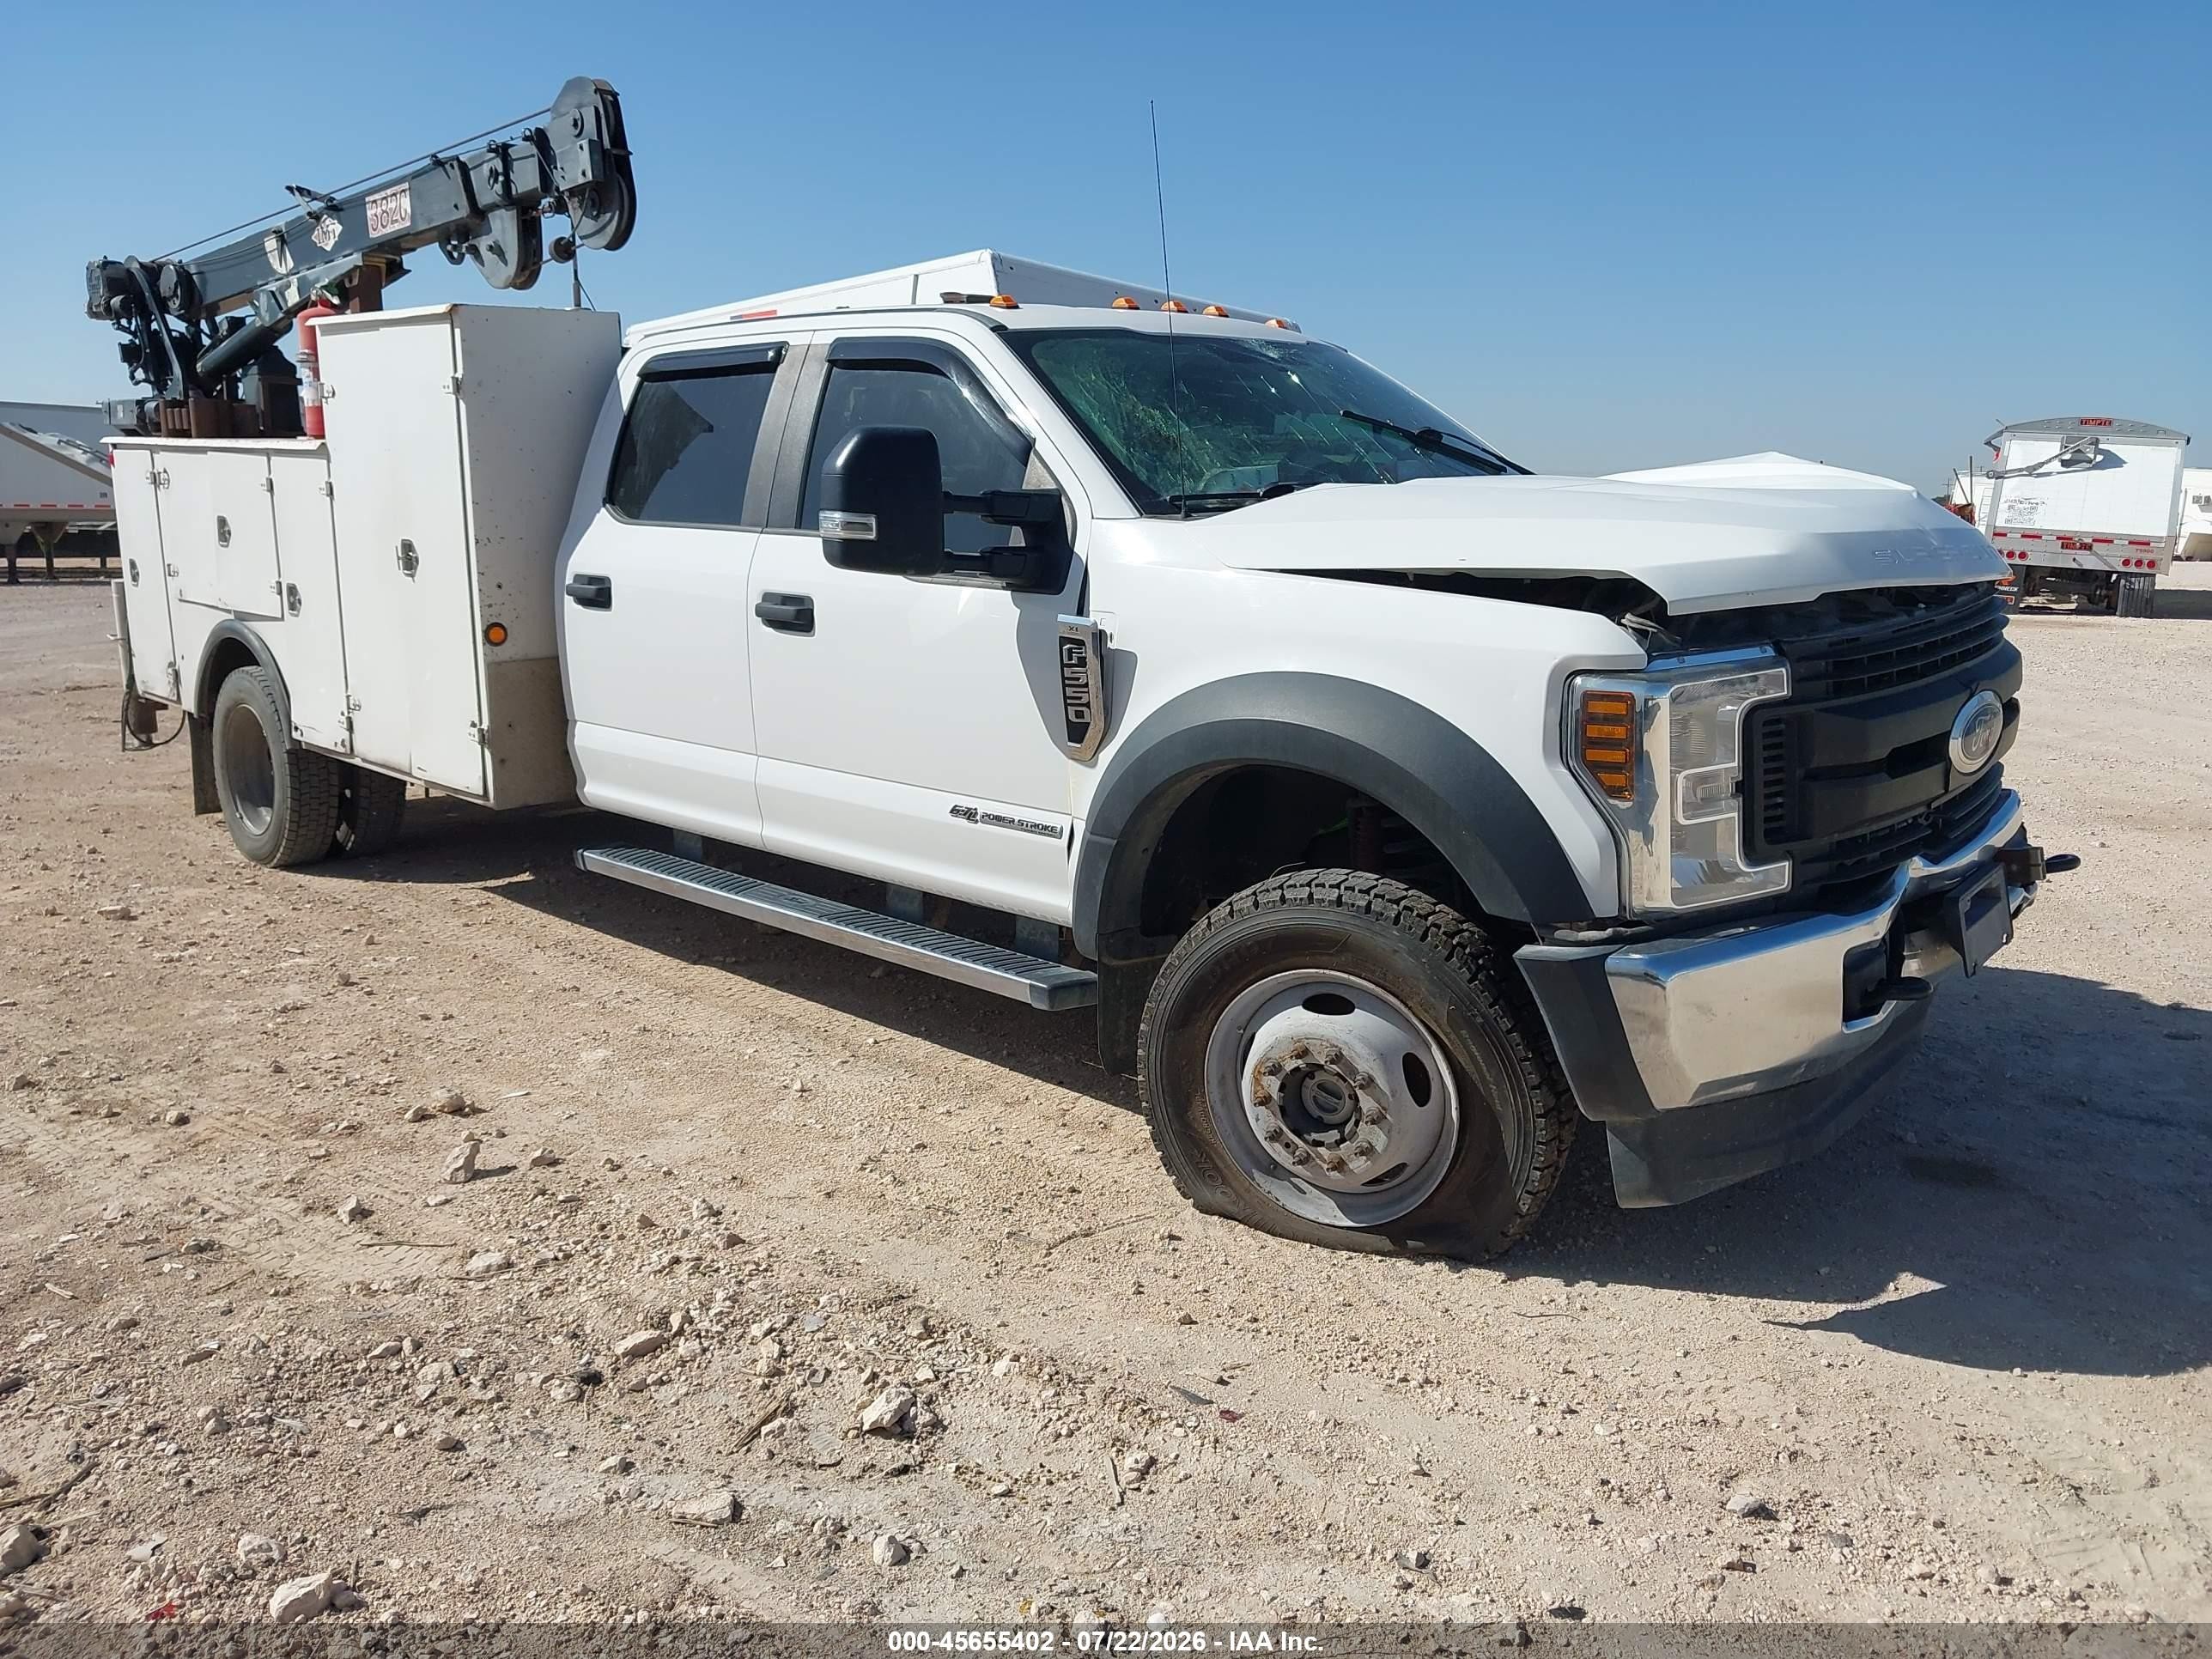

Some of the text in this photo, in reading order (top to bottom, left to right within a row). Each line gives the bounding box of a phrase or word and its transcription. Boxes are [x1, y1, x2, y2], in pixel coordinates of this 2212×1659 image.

[370, 189, 408, 232] 382C
[2081, 417, 2112, 427] TIMPTE
[1063, 644, 1091, 723] F550
[981, 811, 1016, 825] POWER
[1017, 818, 1059, 834] STROKE
